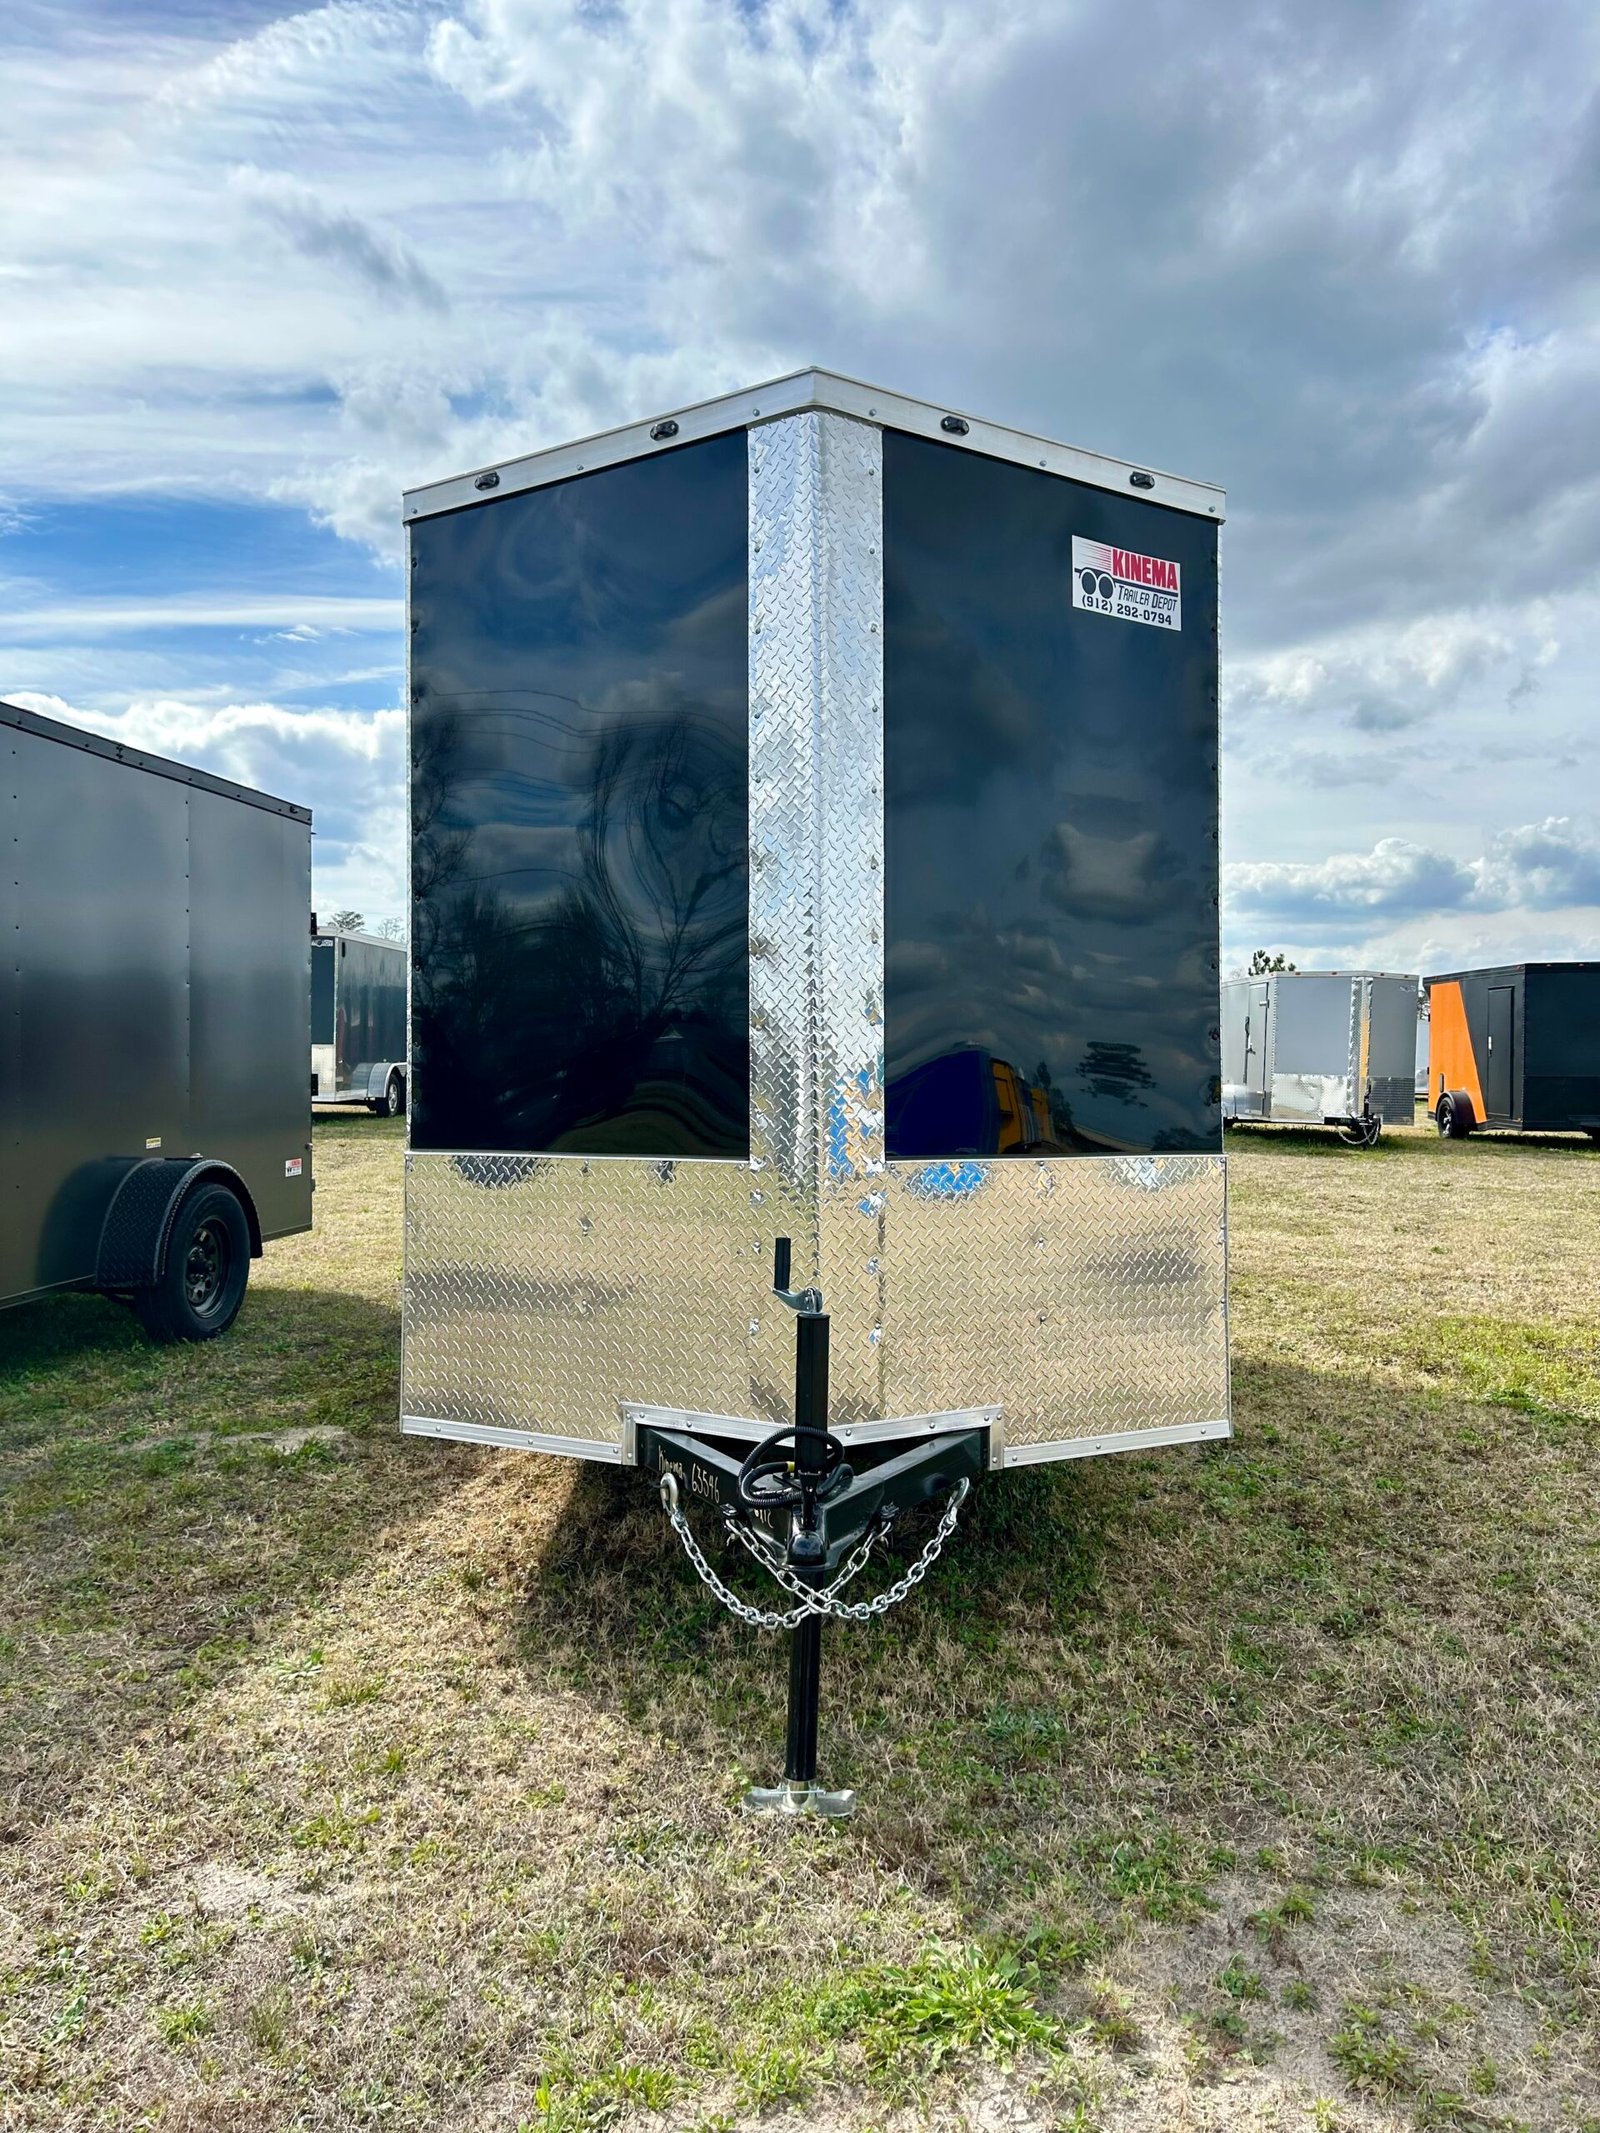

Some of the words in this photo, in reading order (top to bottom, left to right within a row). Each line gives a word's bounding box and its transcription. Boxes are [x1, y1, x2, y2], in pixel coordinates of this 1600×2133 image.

[1112, 548, 1178, 591] KINEMA
[1082, 594, 1113, 614] (912)
[1116, 603, 1172, 625] 292-0794
[1118, 585, 1150, 606] TRAILER
[1151, 593, 1178, 612] DEPOT
